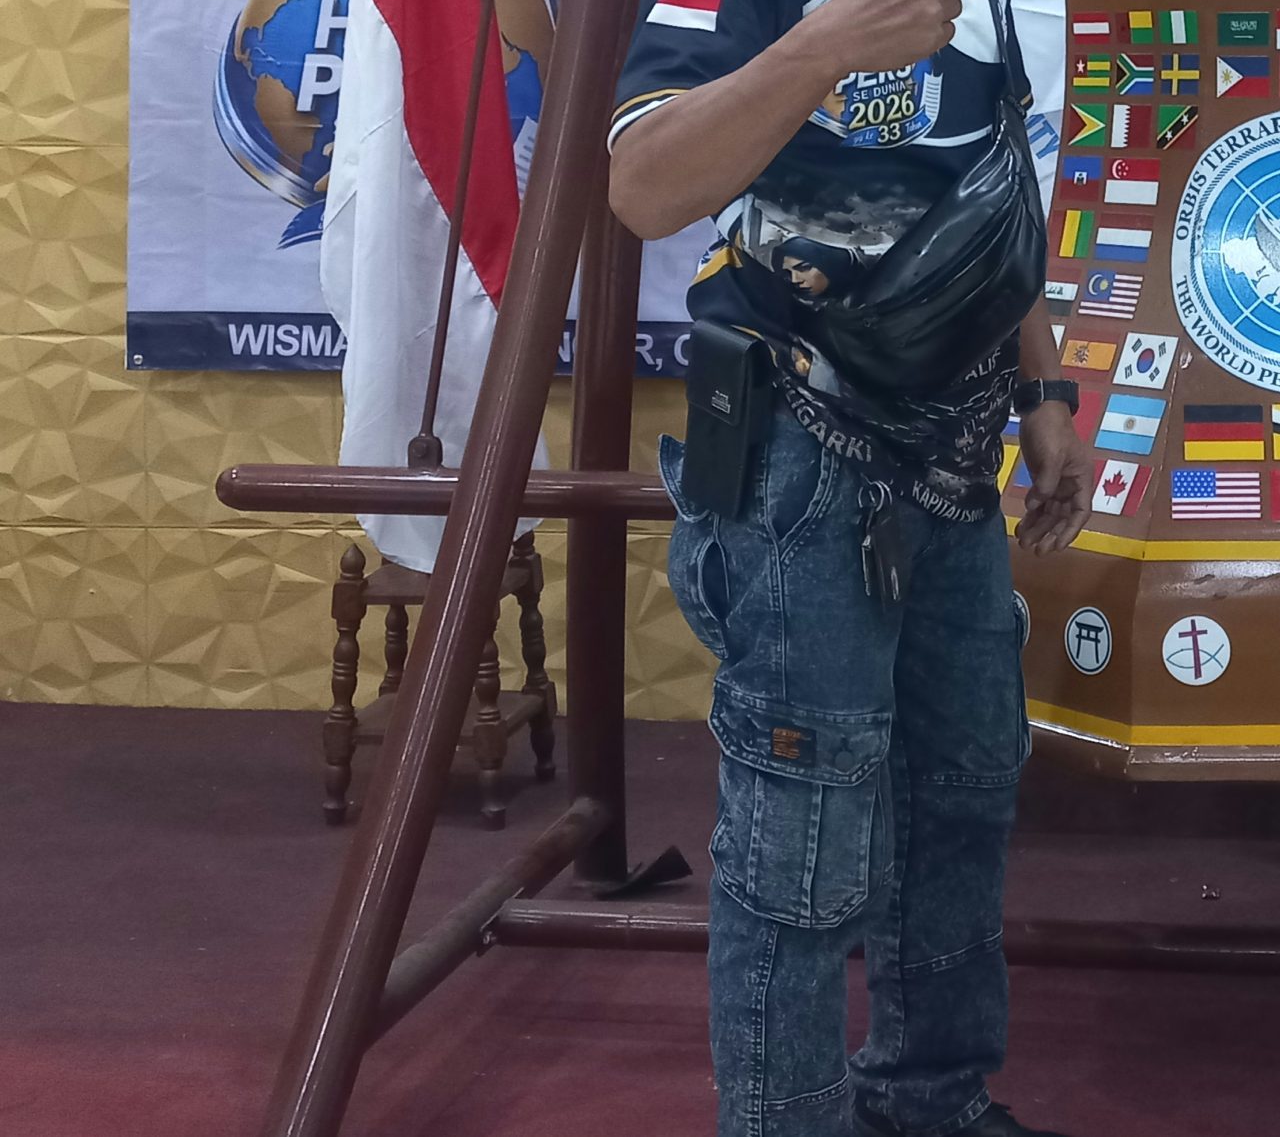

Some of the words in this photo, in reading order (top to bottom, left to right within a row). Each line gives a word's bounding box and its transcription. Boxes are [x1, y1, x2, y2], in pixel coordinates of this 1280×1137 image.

[848, 90, 915, 130] 2026
[853, 89, 869, 102] SE
[873, 80, 906, 98] DUNIA
[877, 123, 901, 143] 33
[1176, 171, 1208, 240] ORBIS
[1175, 275, 1198, 326] THE
[1190, 317, 1255, 376] WORLD
